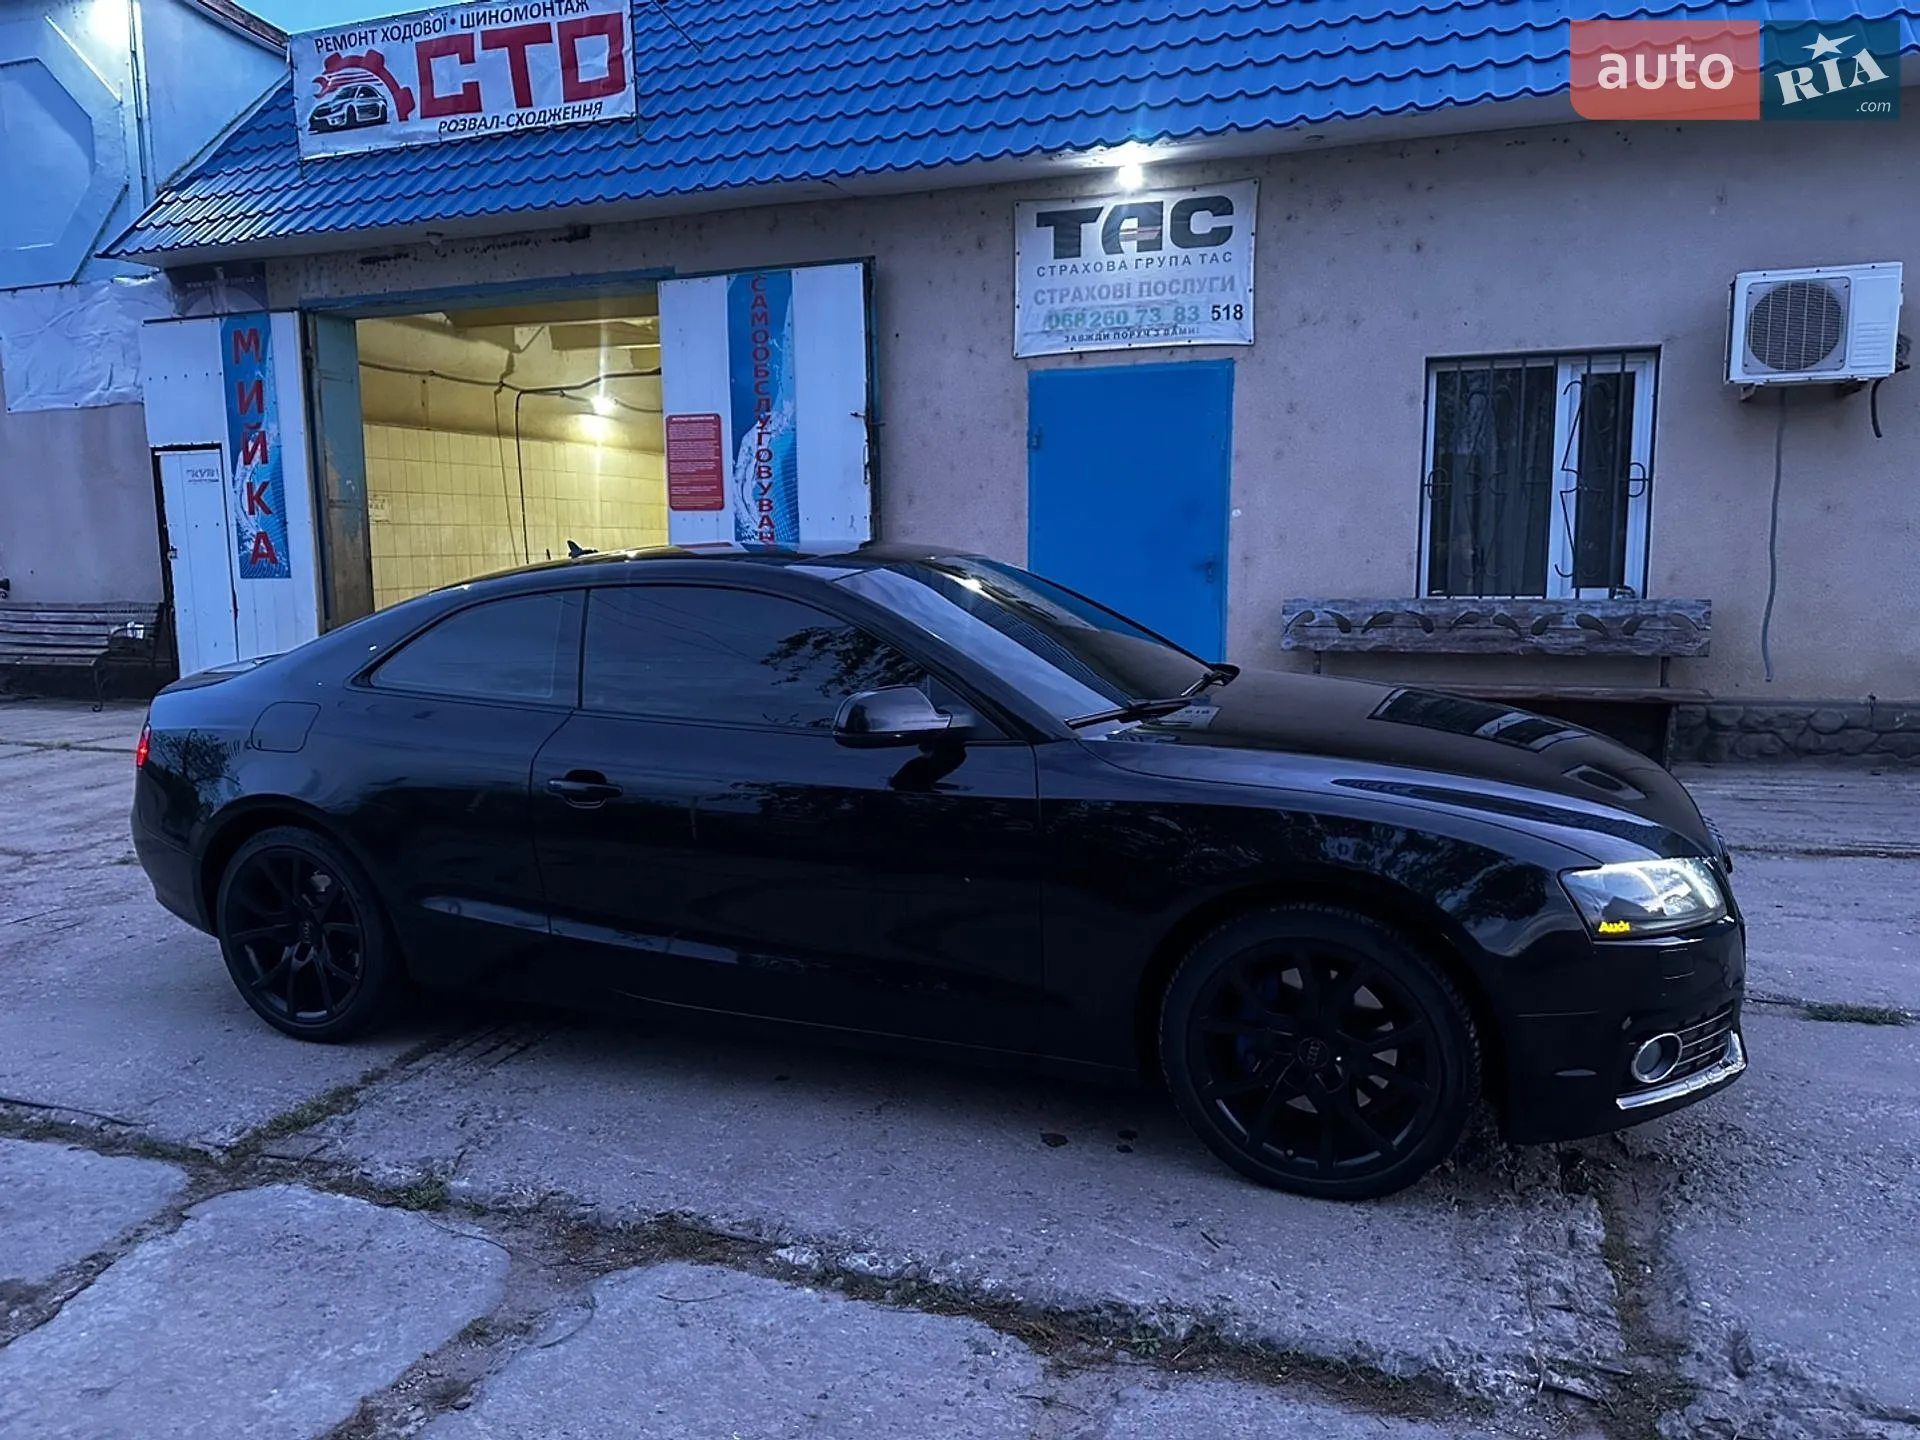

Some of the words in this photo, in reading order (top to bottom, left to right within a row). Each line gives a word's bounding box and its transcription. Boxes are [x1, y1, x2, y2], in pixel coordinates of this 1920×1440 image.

[314, 29, 377, 53] РЕМОНТ
[381, 12, 448, 43] ХОДОВОЇ
[460, 0, 590, 29] ШИНОМОНТАЖ
[415, 12, 627, 119] СТО
[438, 101, 603, 133] РОЗВАЛ-СХОДЖЕННЯ
[1036, 195, 1234, 260] ТАС
[1036, 261, 1128, 278] СТРАХОВА
[1134, 254, 1192, 270] ГРУПА
[1200, 251, 1232, 265] ТАС
[1034, 281, 1131, 305] СТРАХОВІ
[1138, 275, 1236, 300] ПОСЛУГИ
[1211, 303, 1243, 322] 518
[232, 327, 278, 565] МИЙКА
[1598, 919, 1630, 933] Audi
